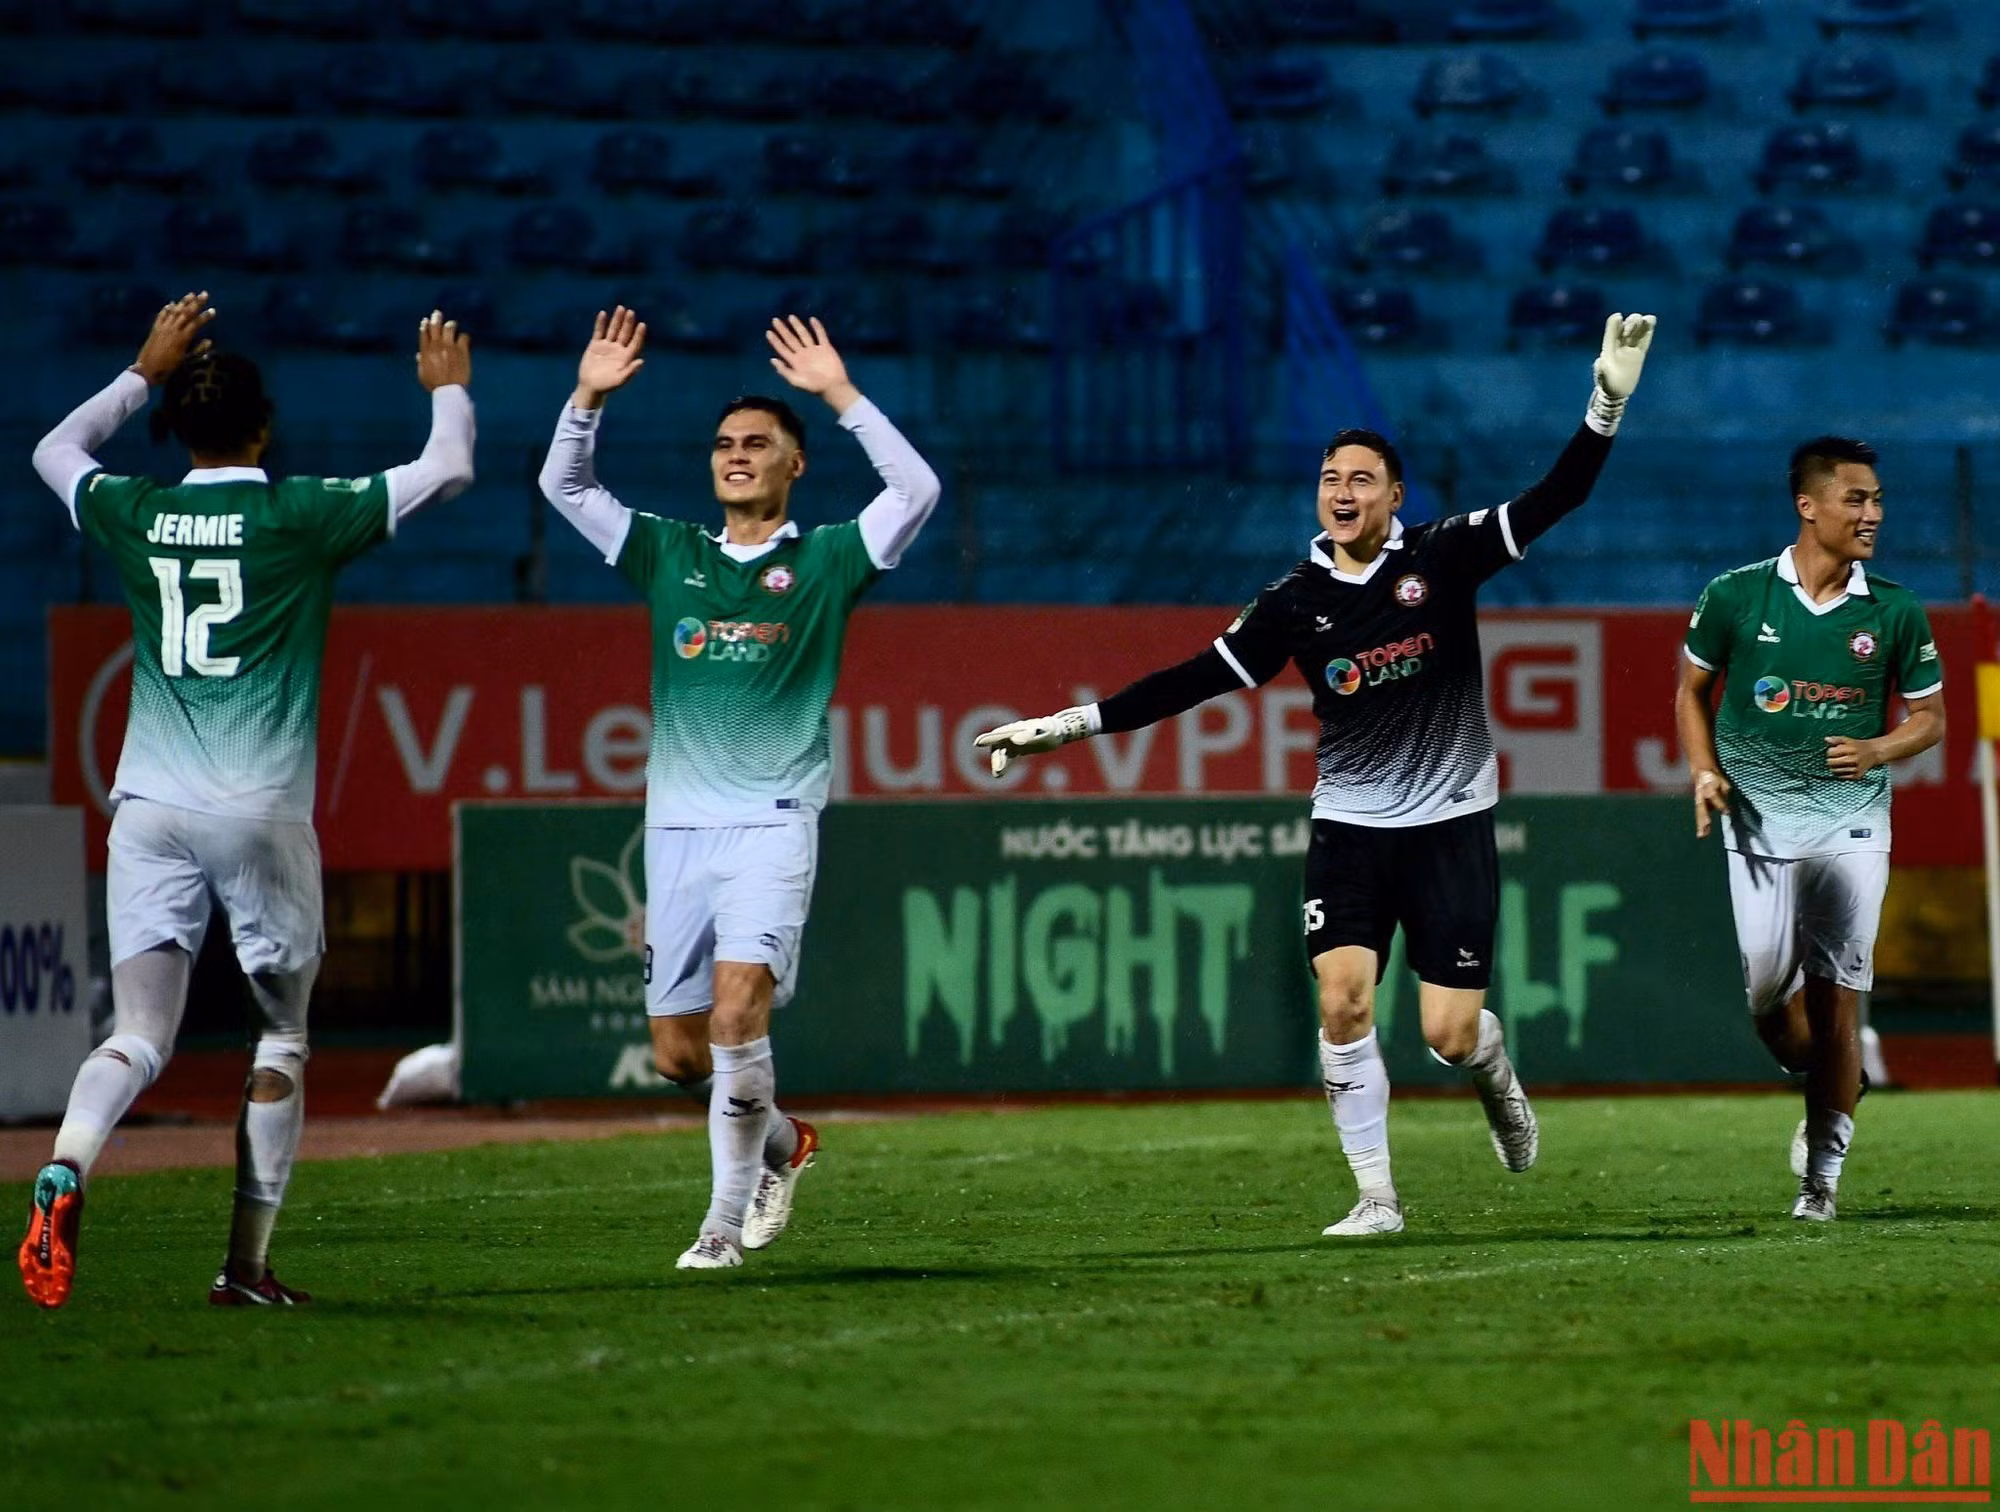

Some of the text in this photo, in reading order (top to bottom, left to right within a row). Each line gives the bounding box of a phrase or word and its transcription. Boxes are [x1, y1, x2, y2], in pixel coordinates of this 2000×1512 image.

[147, 513, 244, 546] JERMIE
[148, 556, 243, 677] 12
[377, 685, 1316, 800] V.Leue.VPF
[905, 867, 1254, 1075] NIGHT
